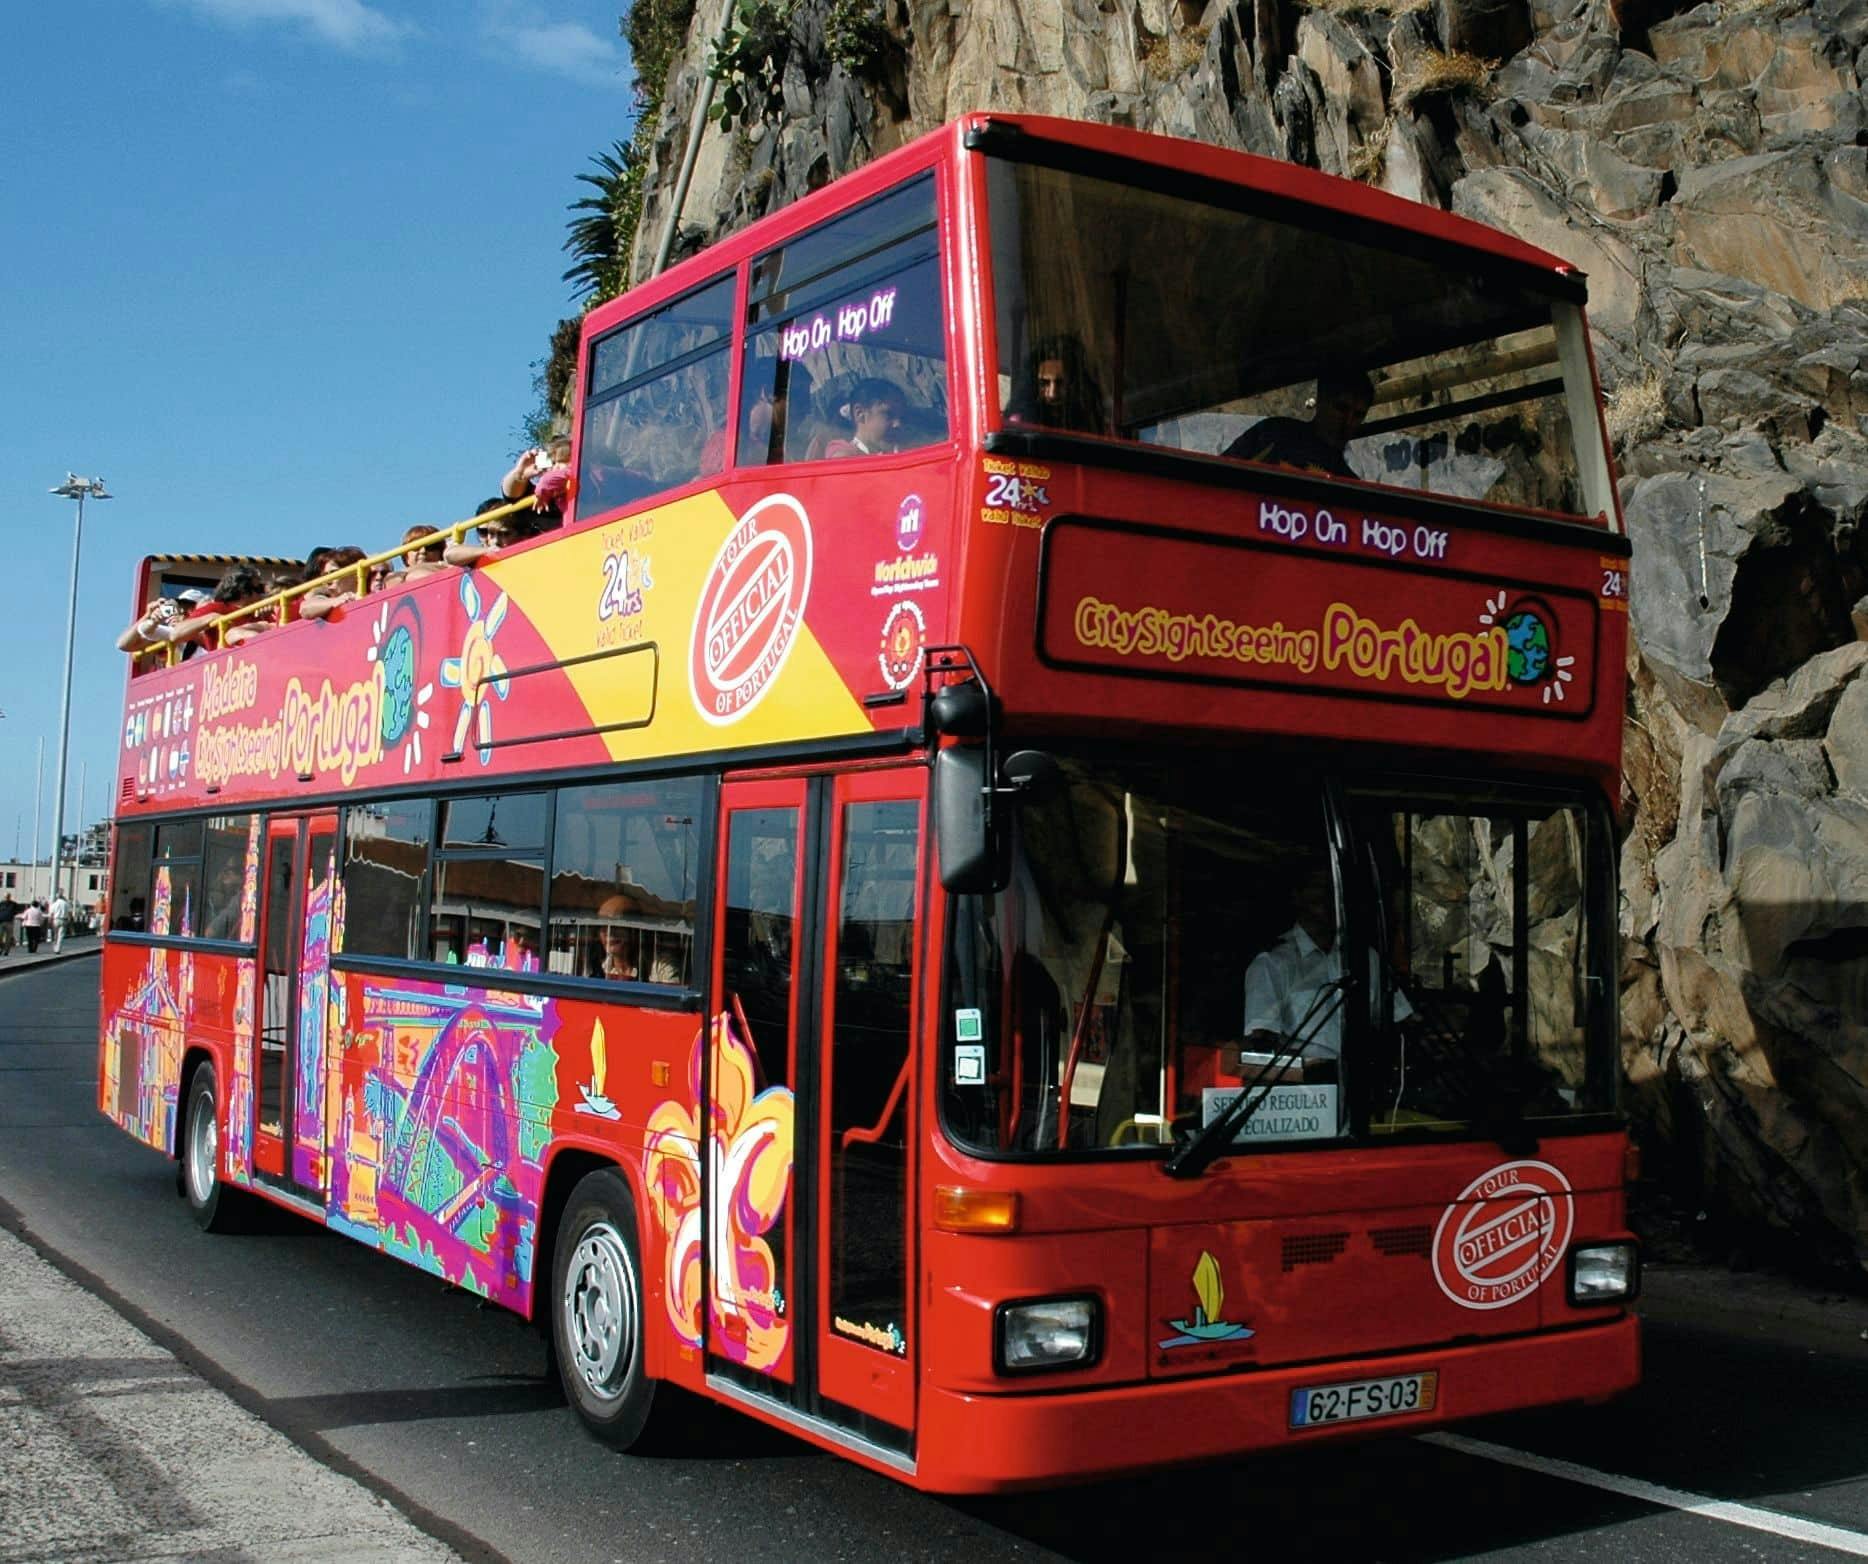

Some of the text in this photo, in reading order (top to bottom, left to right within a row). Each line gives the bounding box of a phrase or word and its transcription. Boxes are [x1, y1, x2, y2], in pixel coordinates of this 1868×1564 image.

[781, 291, 896, 361] Hop On Hop Off
[985, 475, 1020, 508] 24
[718, 517, 758, 577] TOUR
[1260, 502, 1448, 558] Hop On Hop Off
[599, 550, 628, 621] 24
[709, 551, 788, 667] OFFICIAL
[1602, 571, 1620, 596] 24
[715, 607, 798, 713] OF PORTUGAL
[1323, 603, 1507, 698] Portugal
[281, 660, 386, 786] Portugal
[1270, 1094, 1327, 1111] REGULAR
[1475, 1170, 1519, 1199] TOUR
[1460, 1201, 1551, 1264] OFFICIAL
[1468, 1285, 1487, 1301] OF
